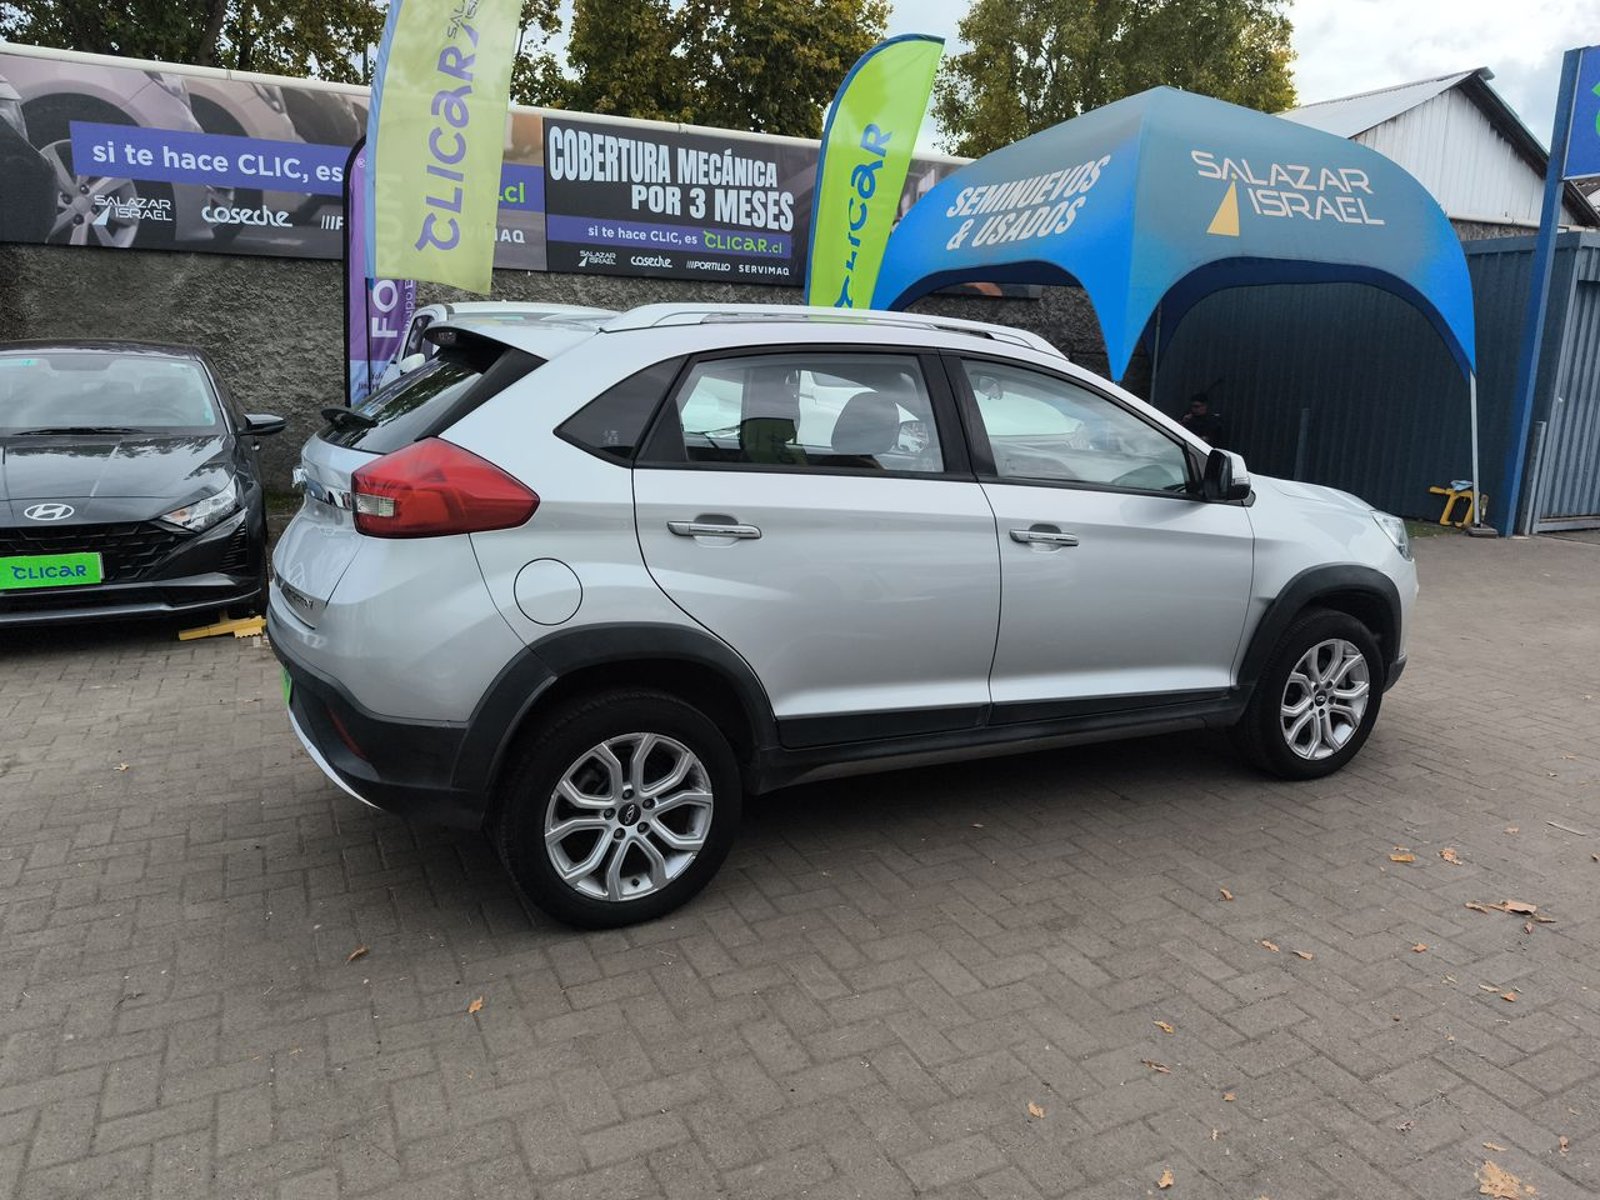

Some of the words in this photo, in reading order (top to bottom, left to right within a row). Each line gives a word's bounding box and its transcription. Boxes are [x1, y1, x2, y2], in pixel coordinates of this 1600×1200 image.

[446, 0, 466, 40] SAL
[92, 141, 115, 163] si
[124, 143, 154, 167] te
[163, 146, 229, 172] hace
[237, 154, 310, 183] CLIC,
[315, 165, 343, 183] es
[549, 125, 671, 184] COBERTURA
[677, 148, 778, 188] MECÁNICA
[1191, 150, 1374, 194] SALAZAR
[94, 194, 172, 211] SALAZAR
[946, 154, 1111, 218] SEMINUEVOS
[114, 207, 173, 222] ISRAEL
[631, 184, 681, 216] POR
[689, 188, 706, 219] 3
[714, 189, 795, 232] MESES
[945, 218, 970, 251] &
[971, 196, 1087, 248] USADOS
[1246, 187, 1386, 225] ISRAEL
[588, 224, 598, 238] si
[601, 226, 615, 239] te
[618, 227, 647, 241] hace
[649, 230, 682, 246] CLIC,
[684, 235, 698, 246] es
[579, 250, 617, 261] SALAZAR
[693, 260, 731, 273] PORTILLO
[738, 263, 790, 277] SERVIMAQ
